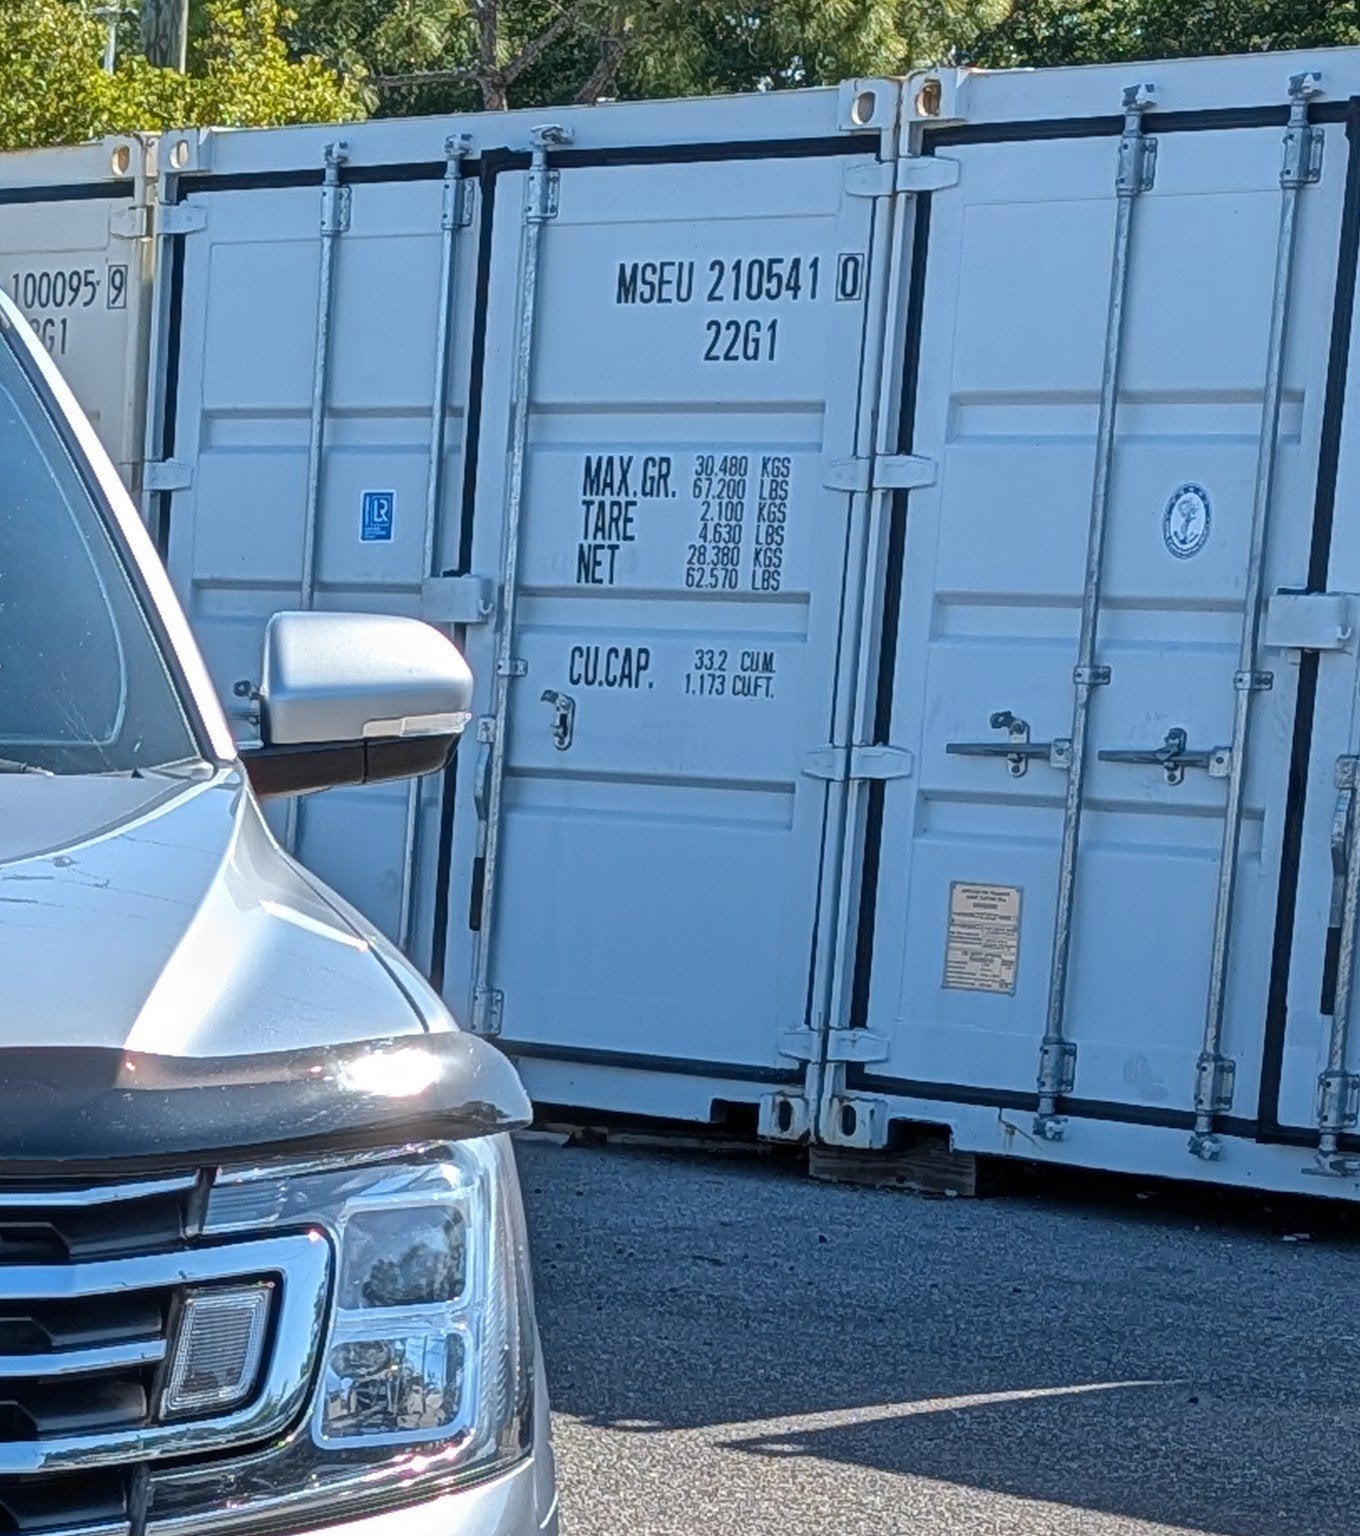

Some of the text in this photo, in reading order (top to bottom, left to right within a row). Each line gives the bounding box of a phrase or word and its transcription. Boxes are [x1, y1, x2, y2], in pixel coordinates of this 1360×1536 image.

[12, 267, 126, 308] 100095 9
[616, 255, 861, 304] MSEU 210541 0
[703, 318, 778, 361] 22G1
[694, 455, 791, 478] 30.480 KGS
[693, 477, 789, 501] 67.200 LBS
[581, 500, 637, 542] TARE
[700, 500, 787, 523] 2.100 KGS
[699, 522, 785, 546] 4.630 LBS
[576, 543, 620, 585] NET
[687, 544, 783, 568] 28.380 KGS
[685, 566, 781, 591] 62.570 LBS
[569, 646, 654, 689] CU.CAP.
[694, 648, 728, 671] 33.2
[685, 672, 726, 696] 1.173
